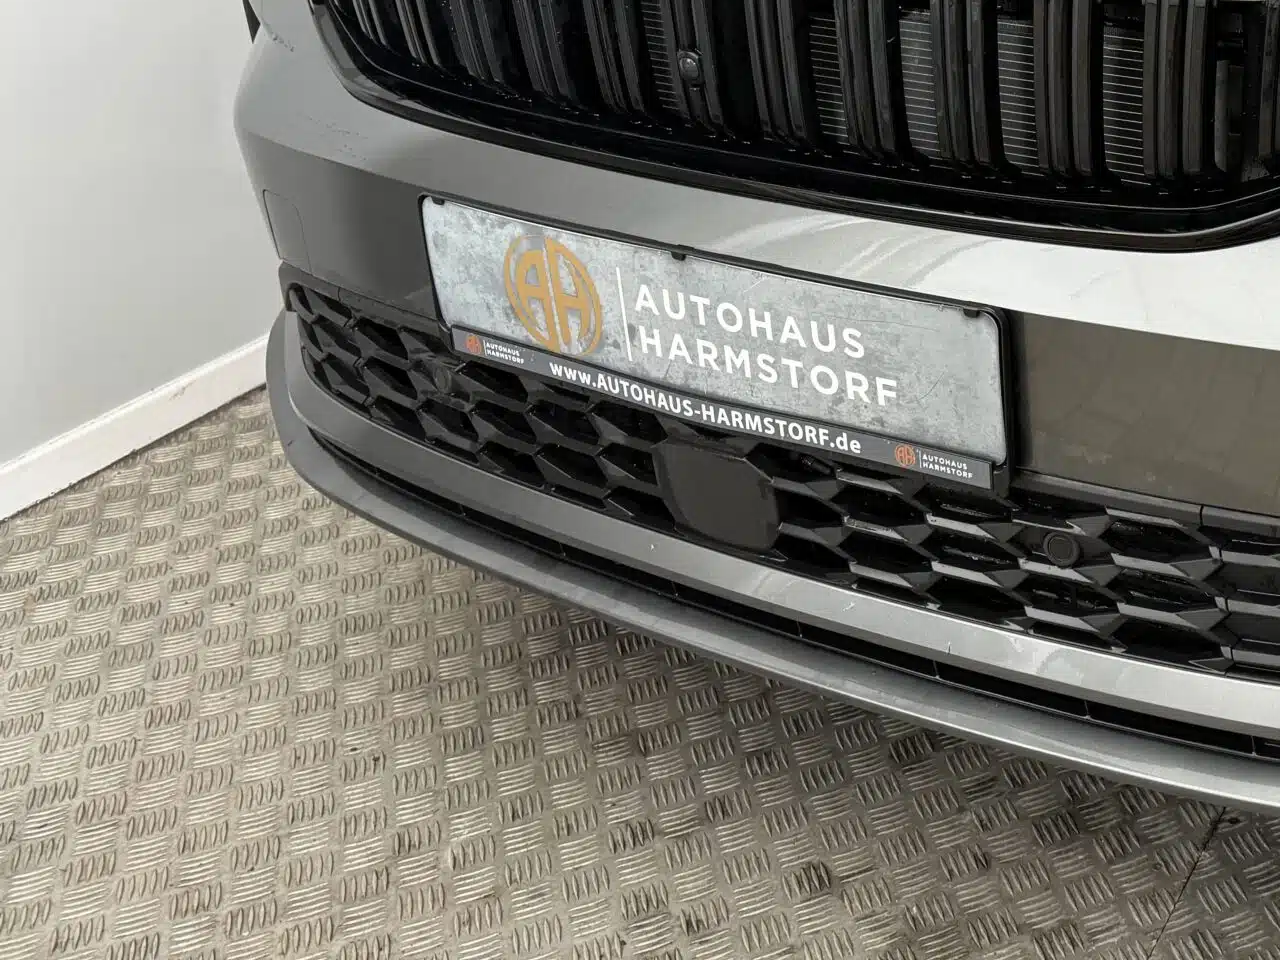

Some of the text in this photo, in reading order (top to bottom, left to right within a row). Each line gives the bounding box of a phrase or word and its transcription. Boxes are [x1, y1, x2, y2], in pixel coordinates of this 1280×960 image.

[634, 283, 866, 359] AUTOHAUS
[486, 342, 520, 356] AUTOHAUS
[486, 349, 524, 364] HARMSTORF
[639, 324, 899, 407] HARMSTORF
[549, 362, 862, 454] www.AUTOHAUS-HARMSTORF.de
[922, 454, 968, 470] AUTOHAUS
[923, 461, 973, 478] HARMSTORF
